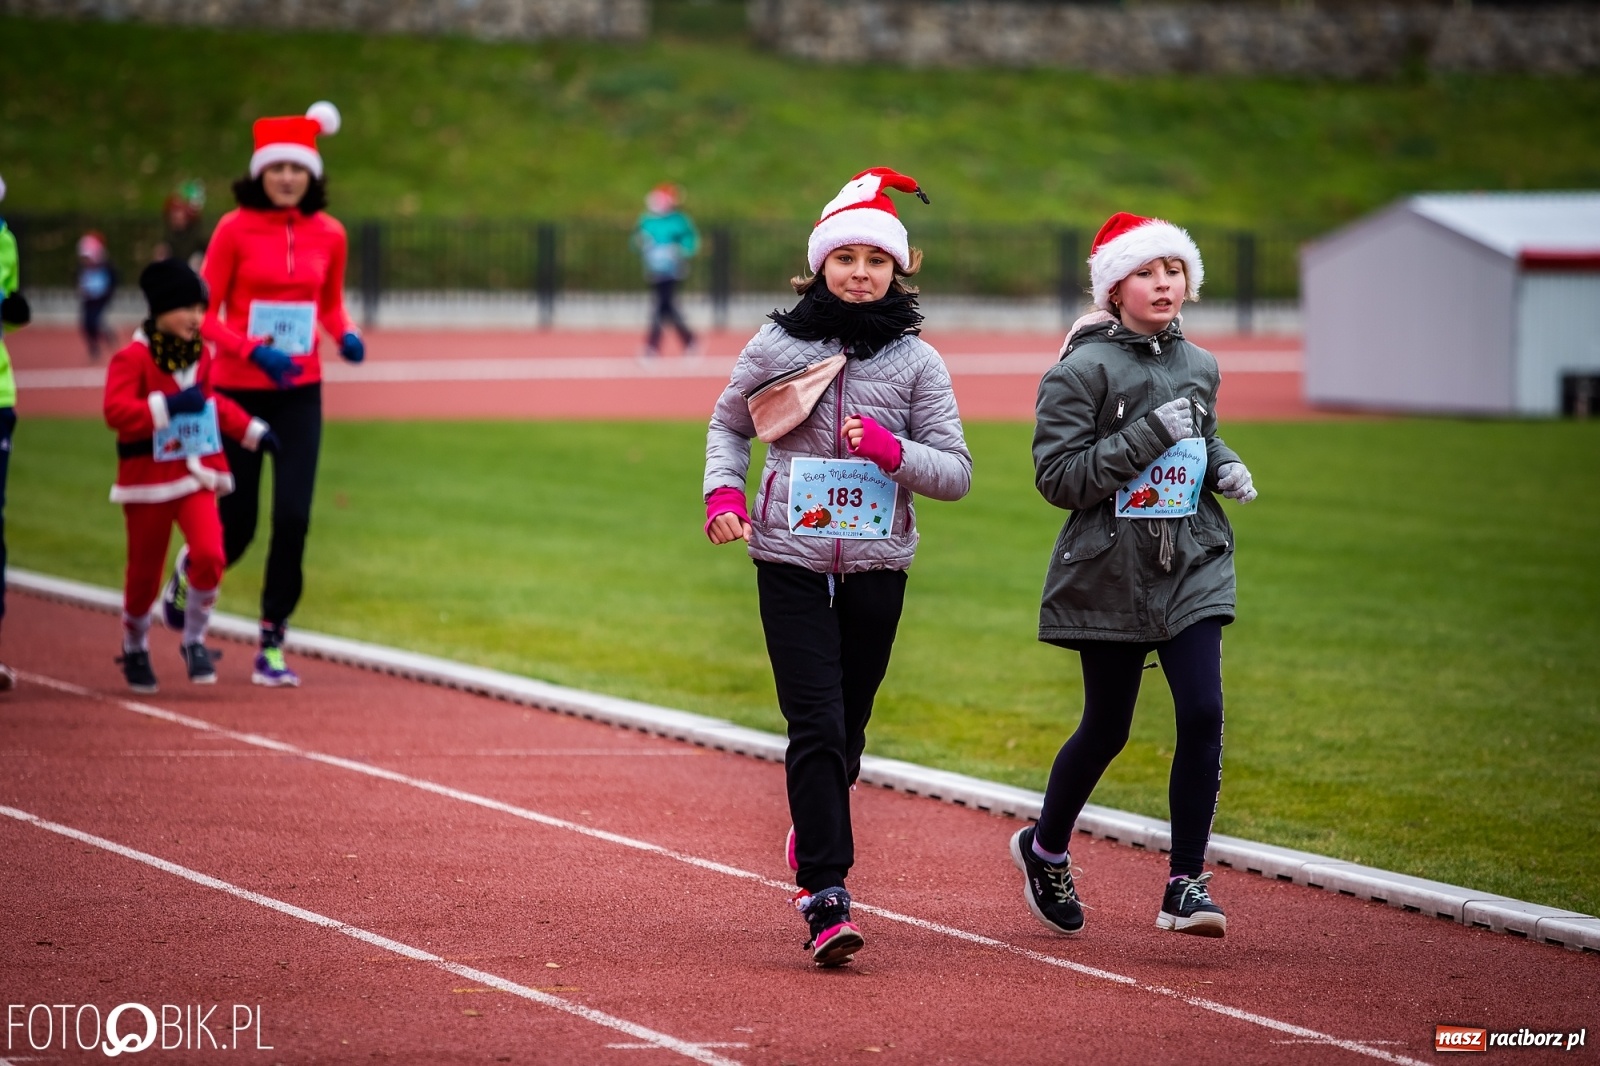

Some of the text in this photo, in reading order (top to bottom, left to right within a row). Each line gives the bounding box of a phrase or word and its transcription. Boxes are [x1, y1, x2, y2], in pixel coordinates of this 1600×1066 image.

[1150, 465, 1187, 485] 046
[827, 487, 863, 507] 183
[1033, 877, 1043, 896] FILA
